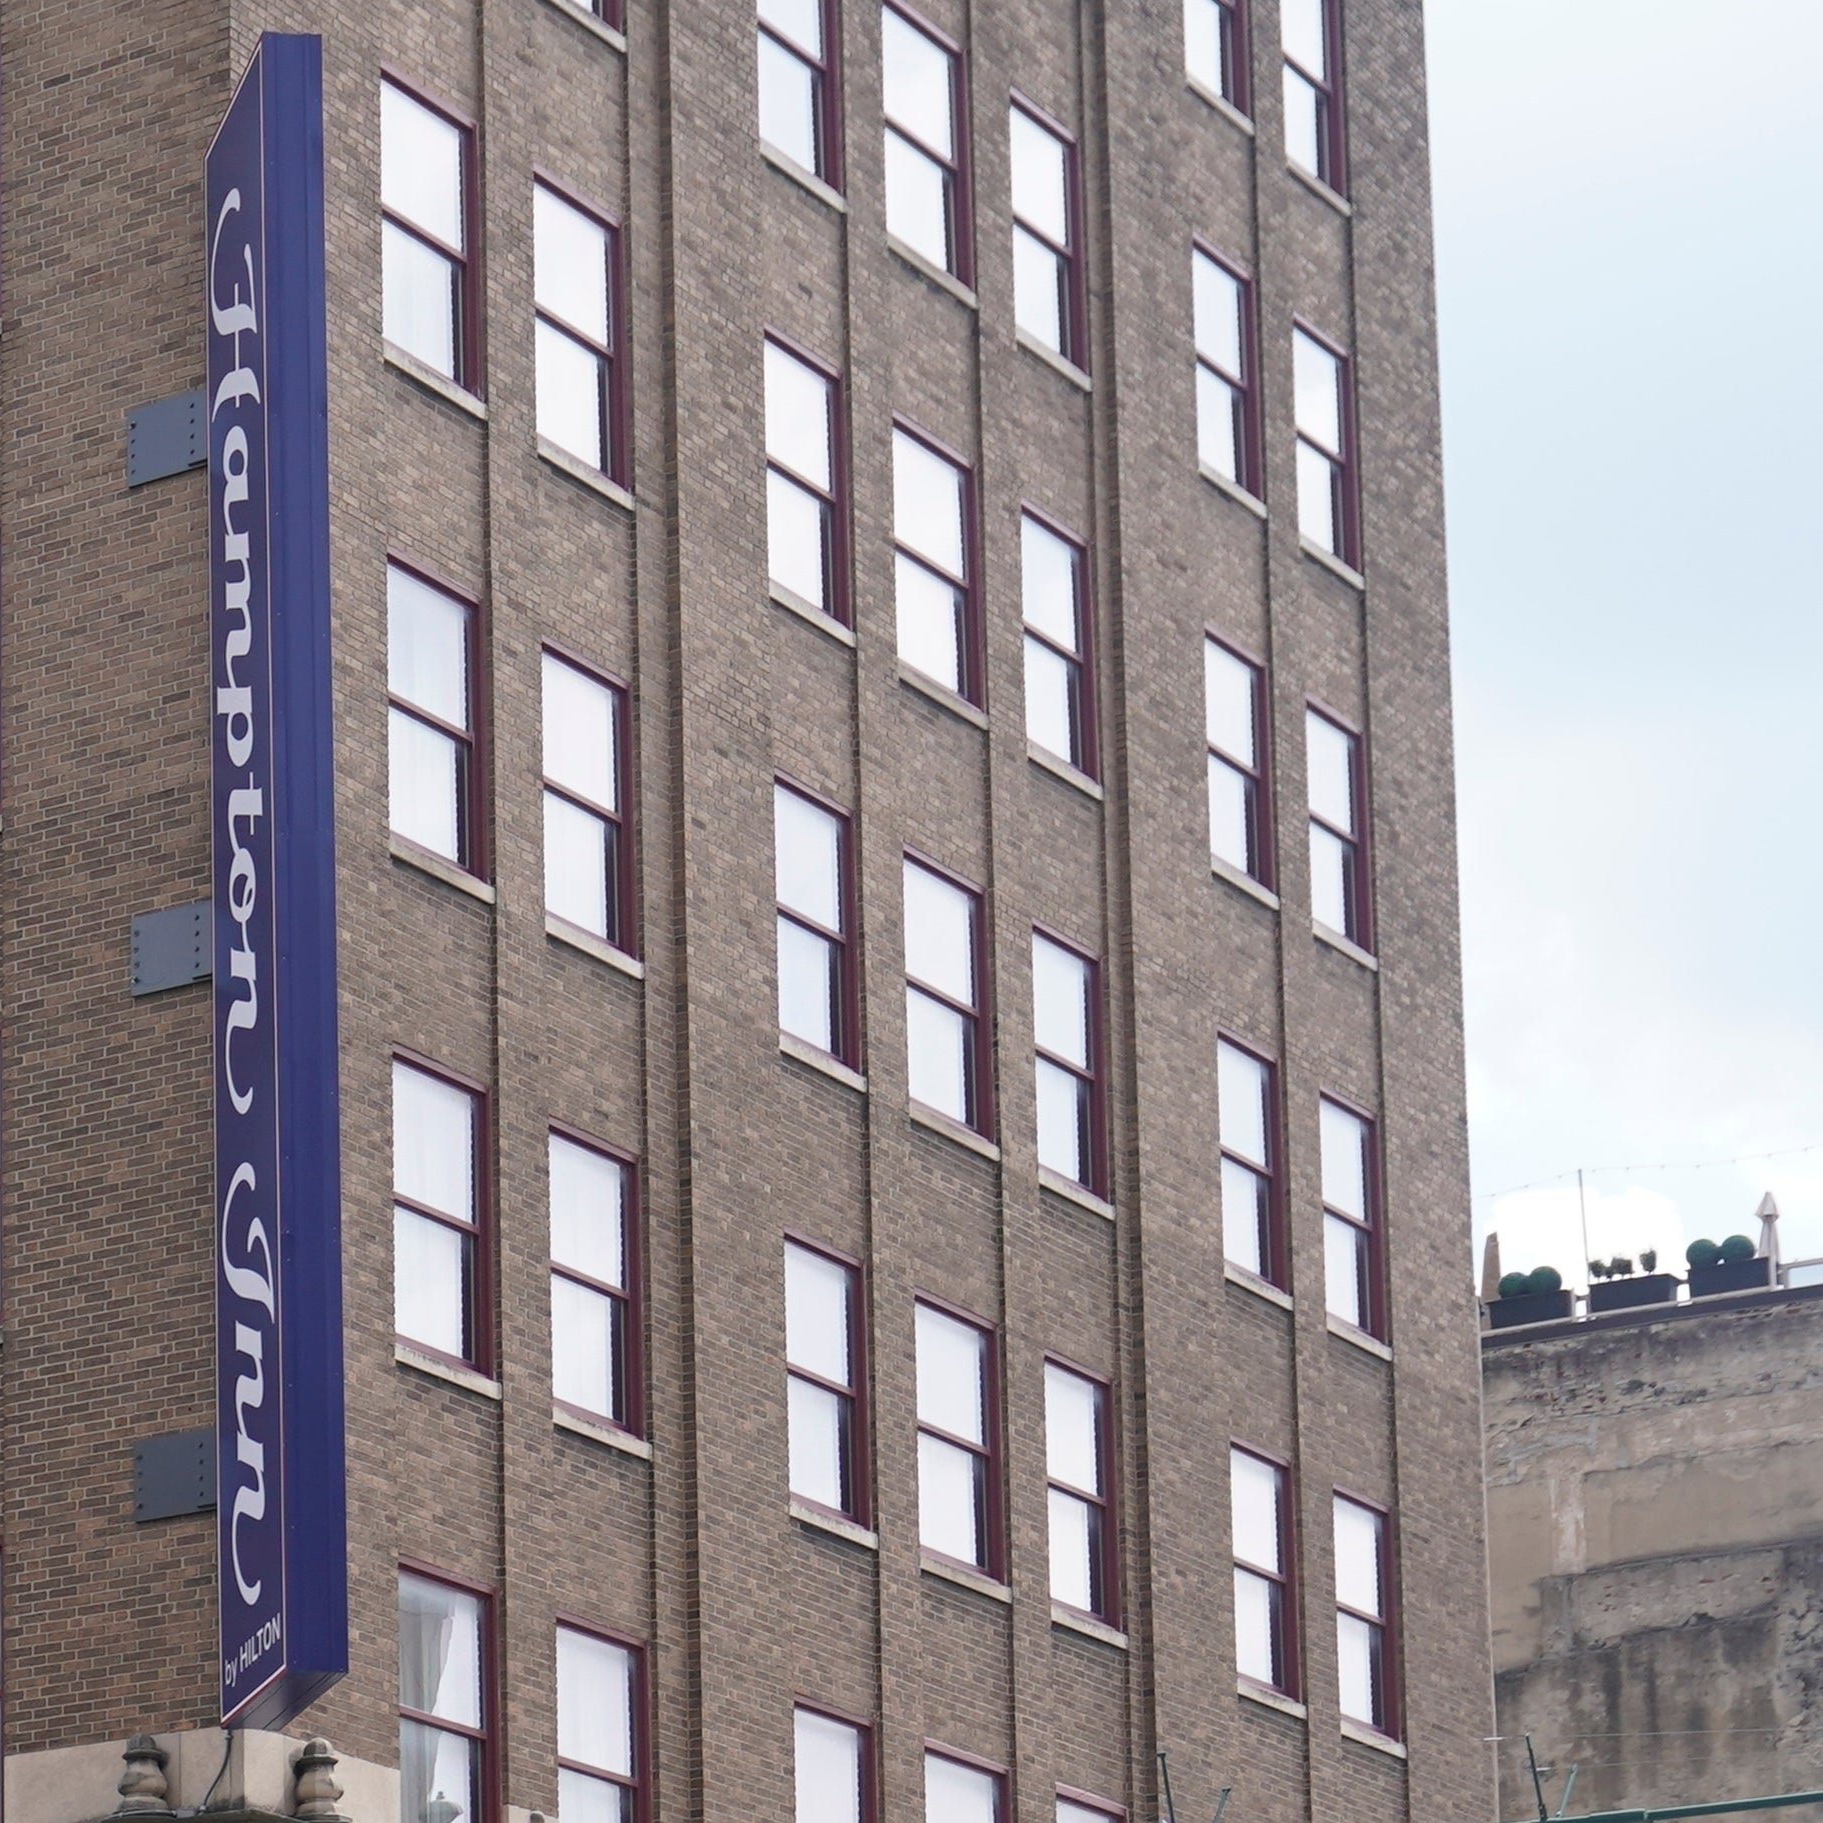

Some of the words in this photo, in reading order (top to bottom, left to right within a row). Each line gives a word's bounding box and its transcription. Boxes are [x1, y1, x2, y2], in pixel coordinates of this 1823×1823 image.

[210, 187, 264, 1116] Hampton
[221, 1161, 275, 1606] Inn
[225, 1657, 238, 1688] by
[240, 1612, 280, 1673] HILTON
